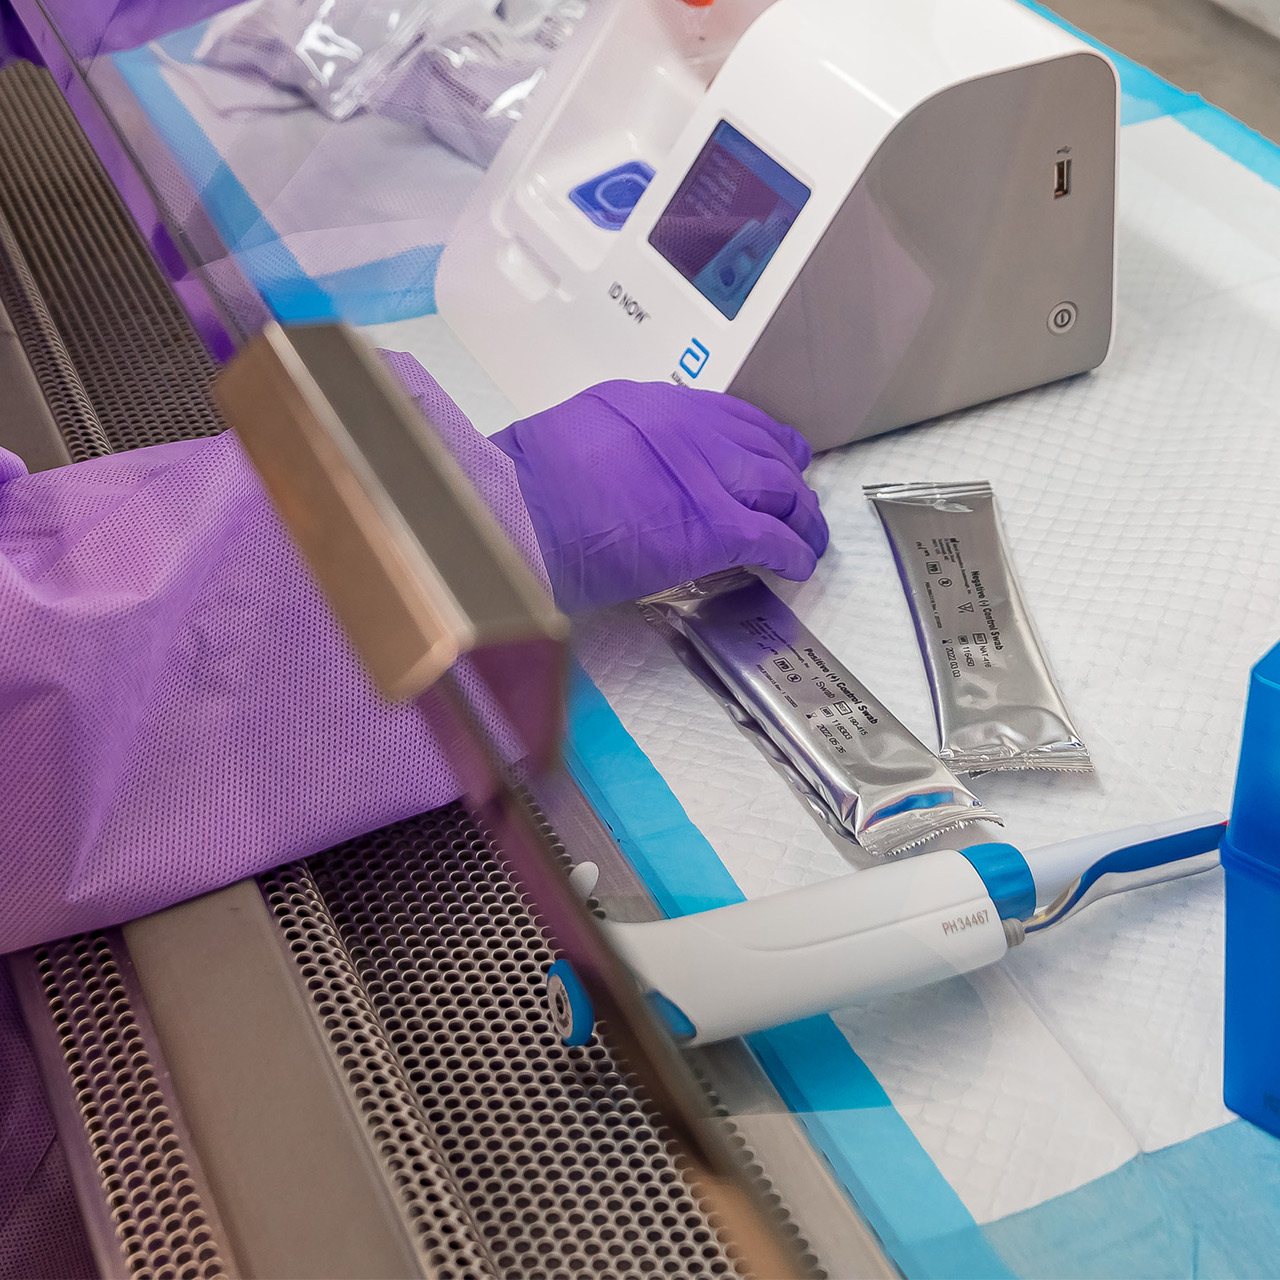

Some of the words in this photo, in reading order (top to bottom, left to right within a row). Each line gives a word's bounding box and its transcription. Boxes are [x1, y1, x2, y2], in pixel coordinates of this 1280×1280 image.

[971, 570, 986, 599] Negative
[983, 608, 998, 631] Control
[990, 631, 1004, 650] Swab
[804, 648, 830, 673] Positive
[836, 682, 862, 704] Control
[858, 705, 878, 724] Swab
[816, 681, 836, 698] Swab
